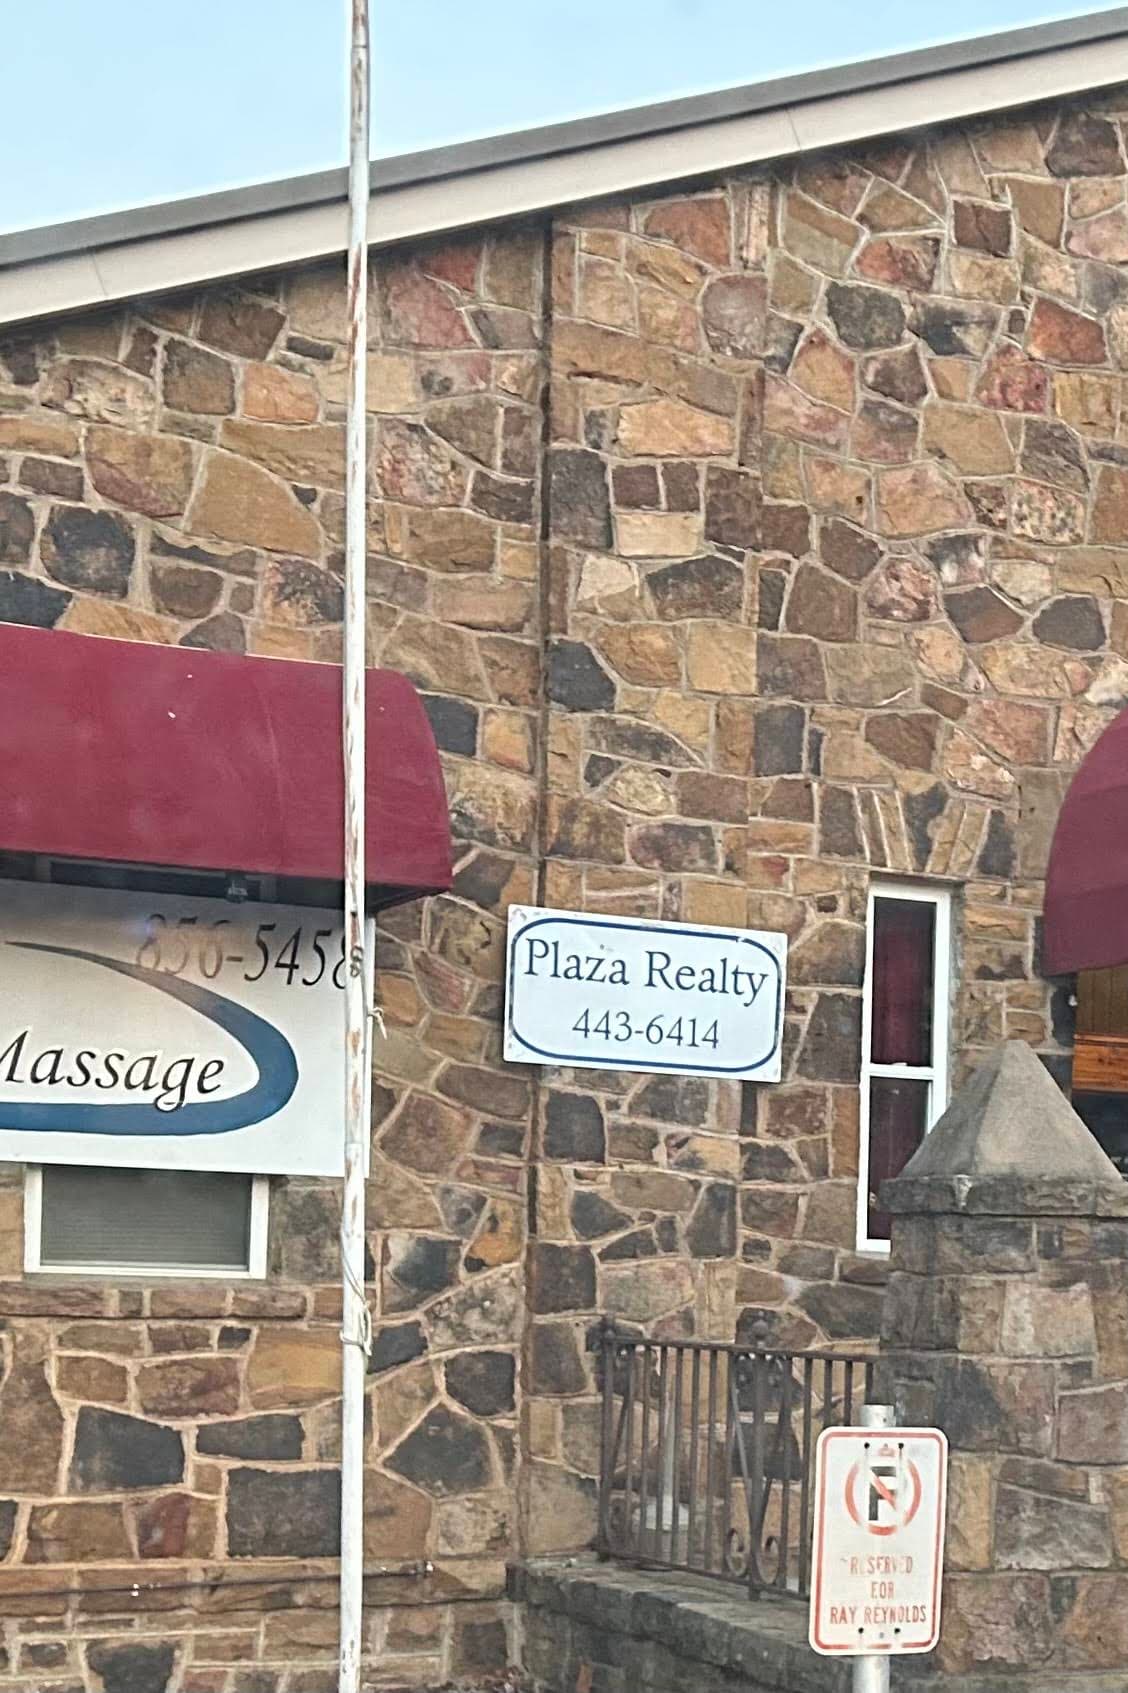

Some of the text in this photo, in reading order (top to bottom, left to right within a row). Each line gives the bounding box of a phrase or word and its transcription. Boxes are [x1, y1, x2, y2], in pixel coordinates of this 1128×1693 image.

[524, 937, 769, 1007] Plaza Realty
[572, 1008, 719, 1050] 443-6414
[850, 1556, 913, 1574] RSERVD
[870, 1581, 895, 1599] FOR
[830, 1605, 926, 1624] RAY REYNOLDS
